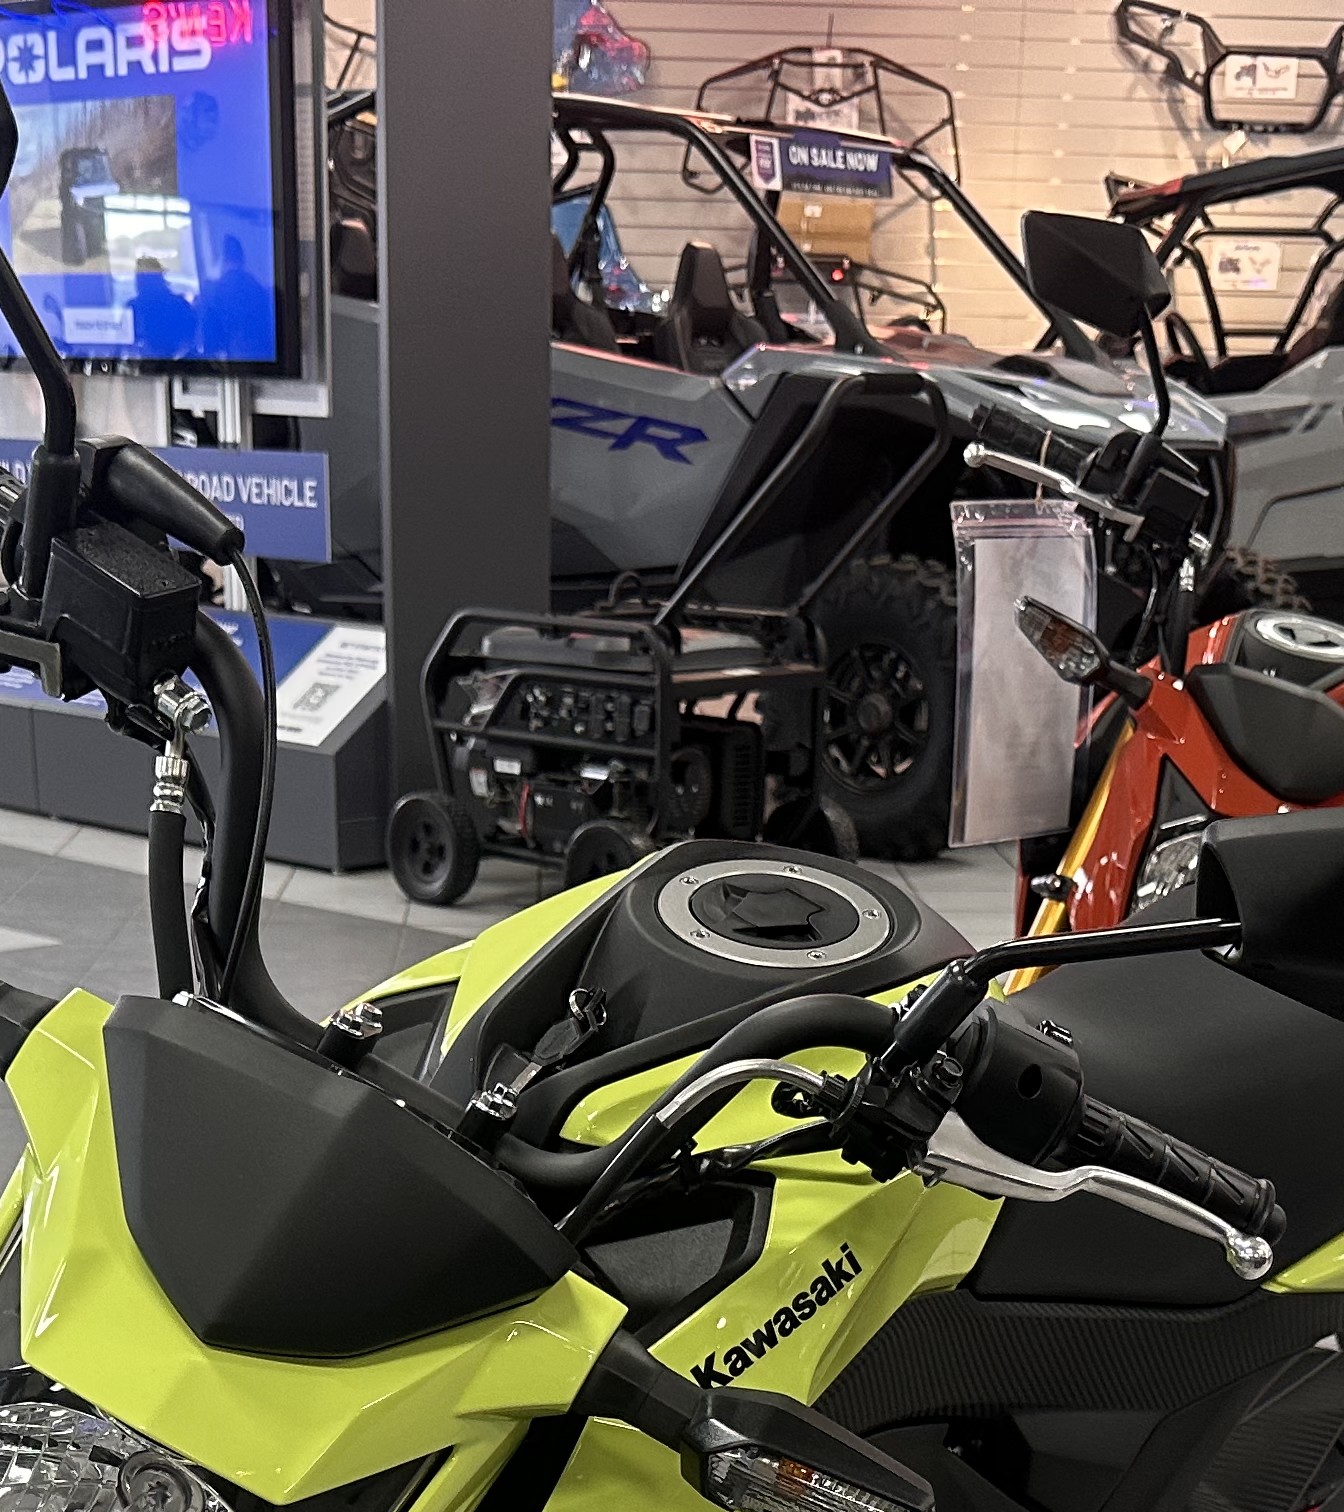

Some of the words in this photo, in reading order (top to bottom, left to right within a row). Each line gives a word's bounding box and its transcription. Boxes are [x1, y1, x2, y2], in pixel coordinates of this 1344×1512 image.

[788, 145, 810, 167] ON
[809, 146, 846, 170] SALE
[845, 150, 879, 172] NOW
[551, 397, 711, 466] ZR
[236, 473, 318, 508] VEHICLE
[689, 1241, 863, 1390] Kawasaki
